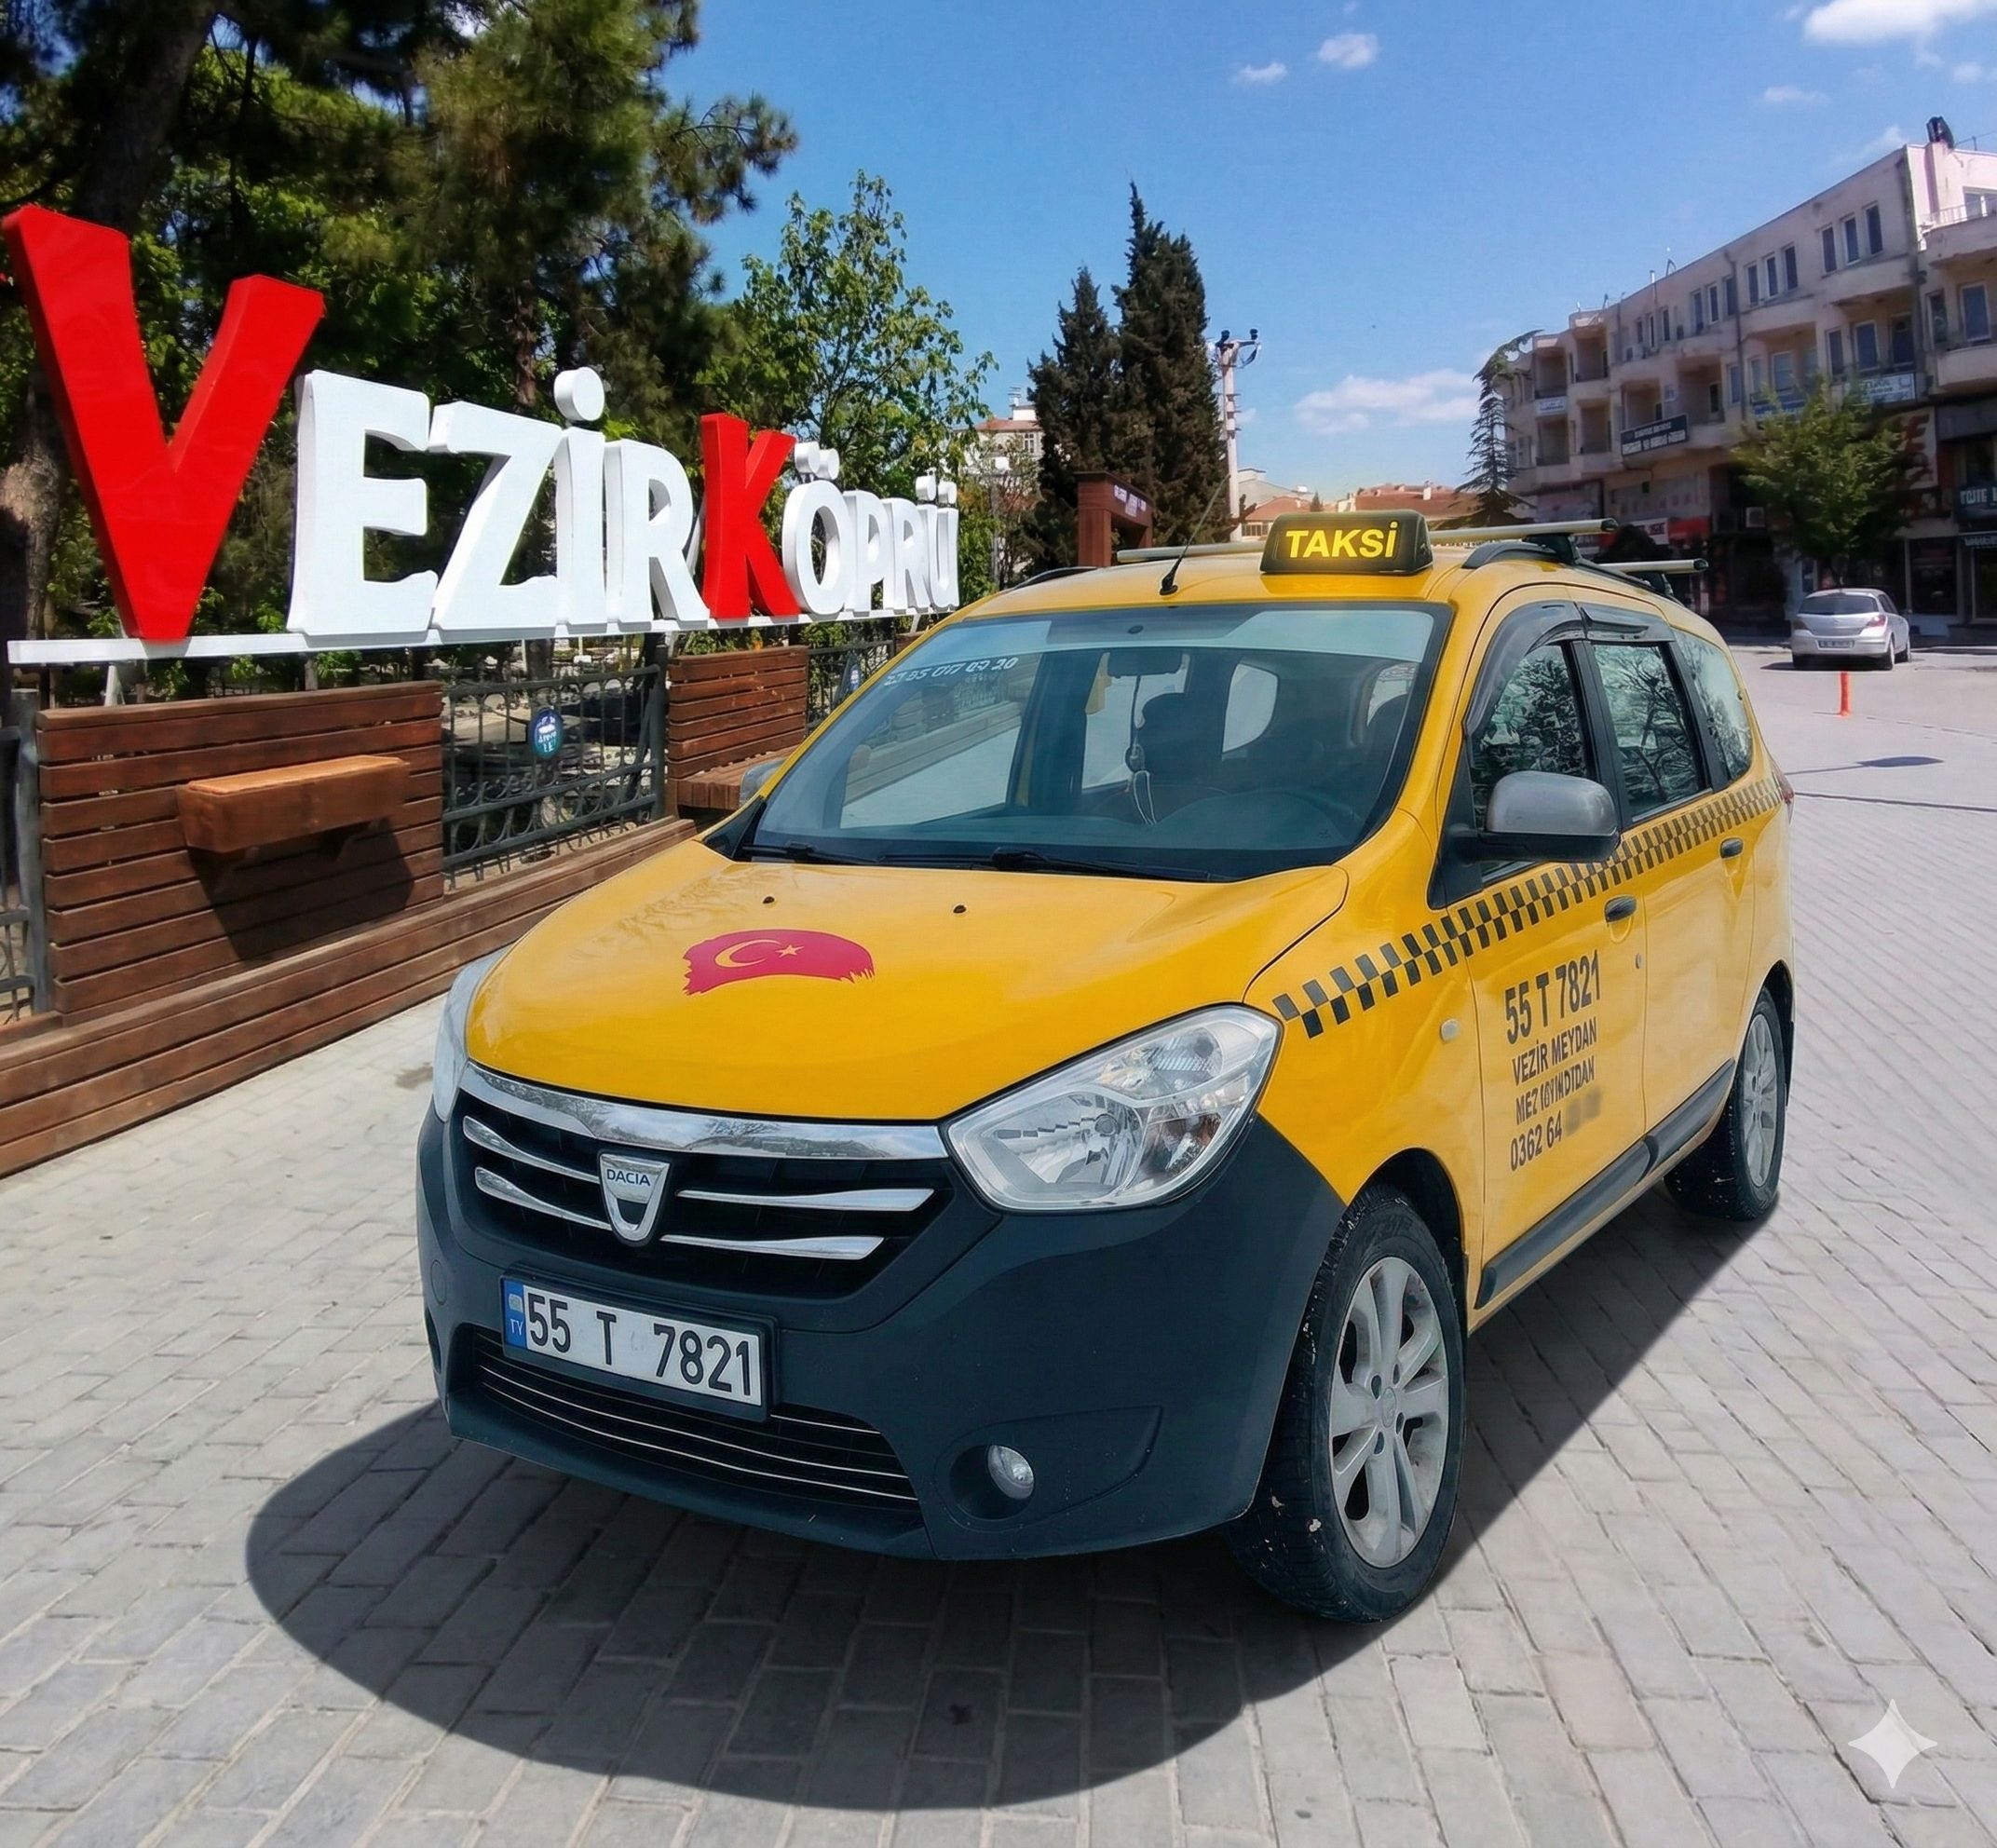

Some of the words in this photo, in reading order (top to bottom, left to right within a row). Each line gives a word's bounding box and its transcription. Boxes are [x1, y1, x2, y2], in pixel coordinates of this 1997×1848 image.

[3, 204, 958, 642] VEZİRKÖPRÜ
[1285, 522, 1398, 558] TAKSİ
[1504, 980, 1532, 1044] 55
[1536, 972, 1550, 1027] T
[1555, 949, 1601, 1019] 7821
[1551, 1016, 1597, 1067] MEYDAN
[1510, 1123, 1542, 1172] 0362
[1546, 1109, 1562, 1148] 64
[606, 1168, 651, 1187] DACIA
[527, 1292, 571, 1353] 55
[596, 1311, 617, 1366] T
[653, 1323, 751, 1396] 7821
